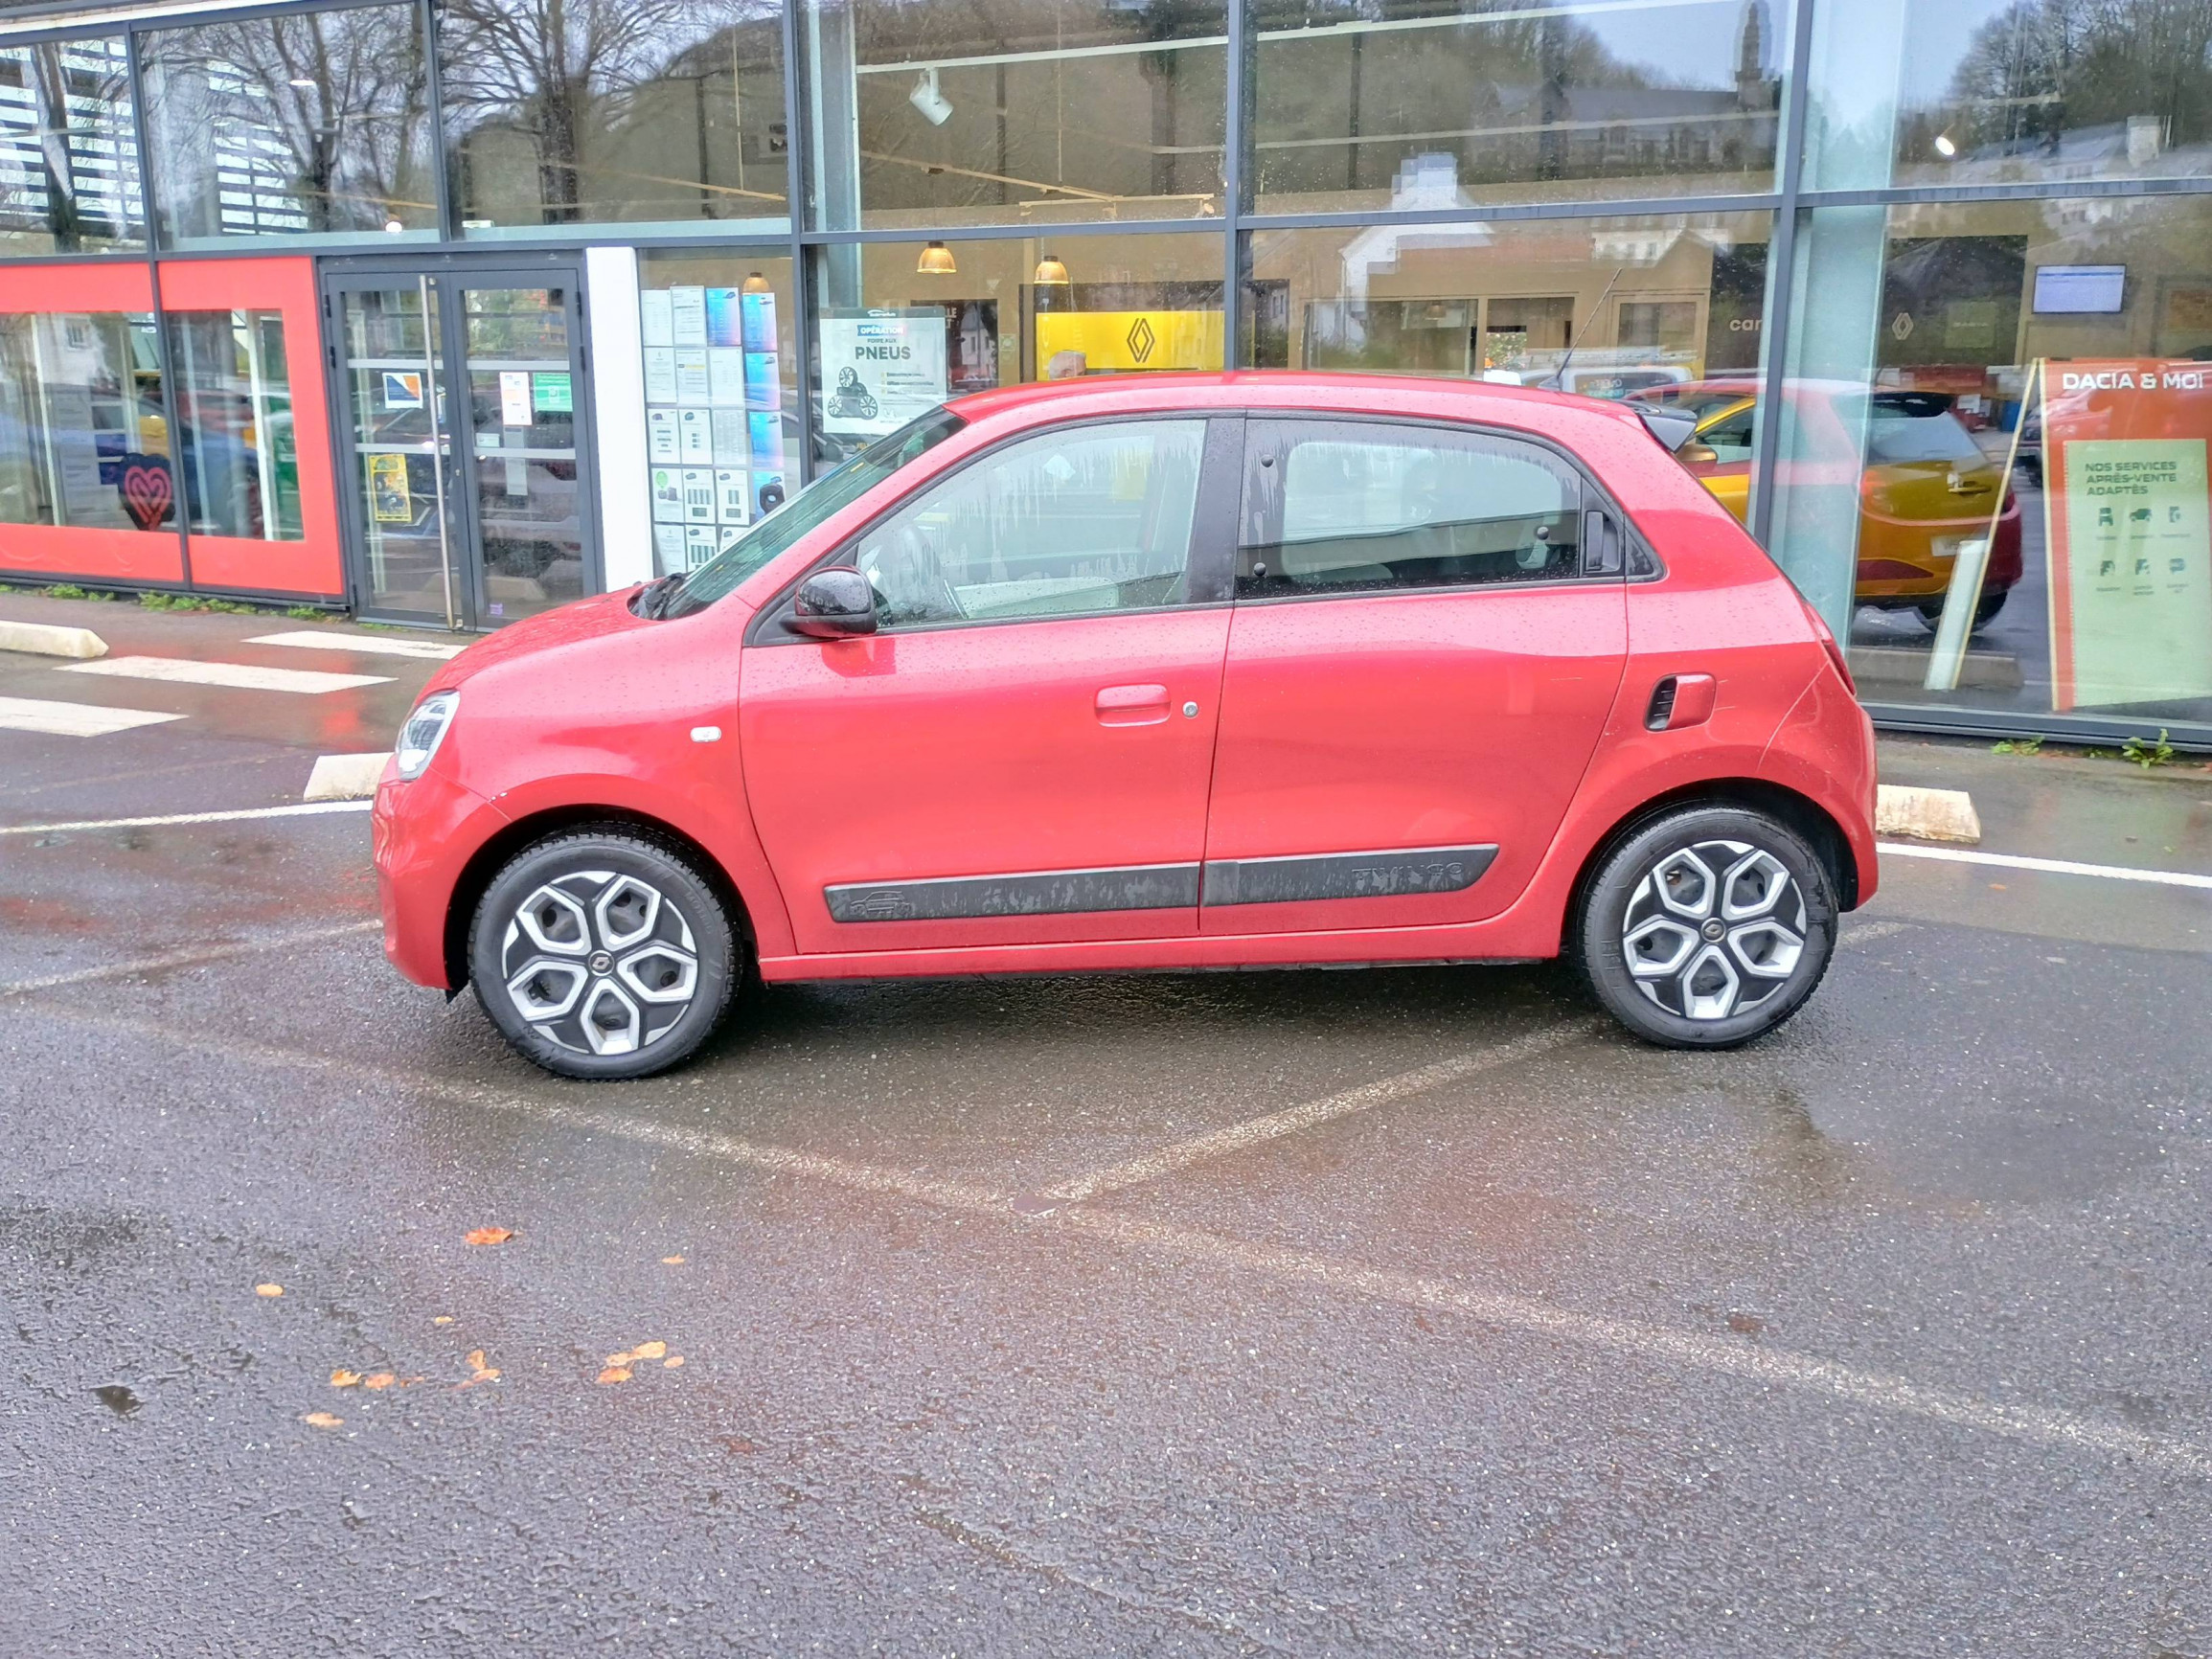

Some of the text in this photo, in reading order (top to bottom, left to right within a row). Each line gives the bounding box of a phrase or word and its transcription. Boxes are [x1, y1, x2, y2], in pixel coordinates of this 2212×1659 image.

[855, 346, 911, 360] PNEUS
[2062, 373, 2204, 390] DACIA & MOI
[2085, 462, 2178, 472] NOS SERVICES
